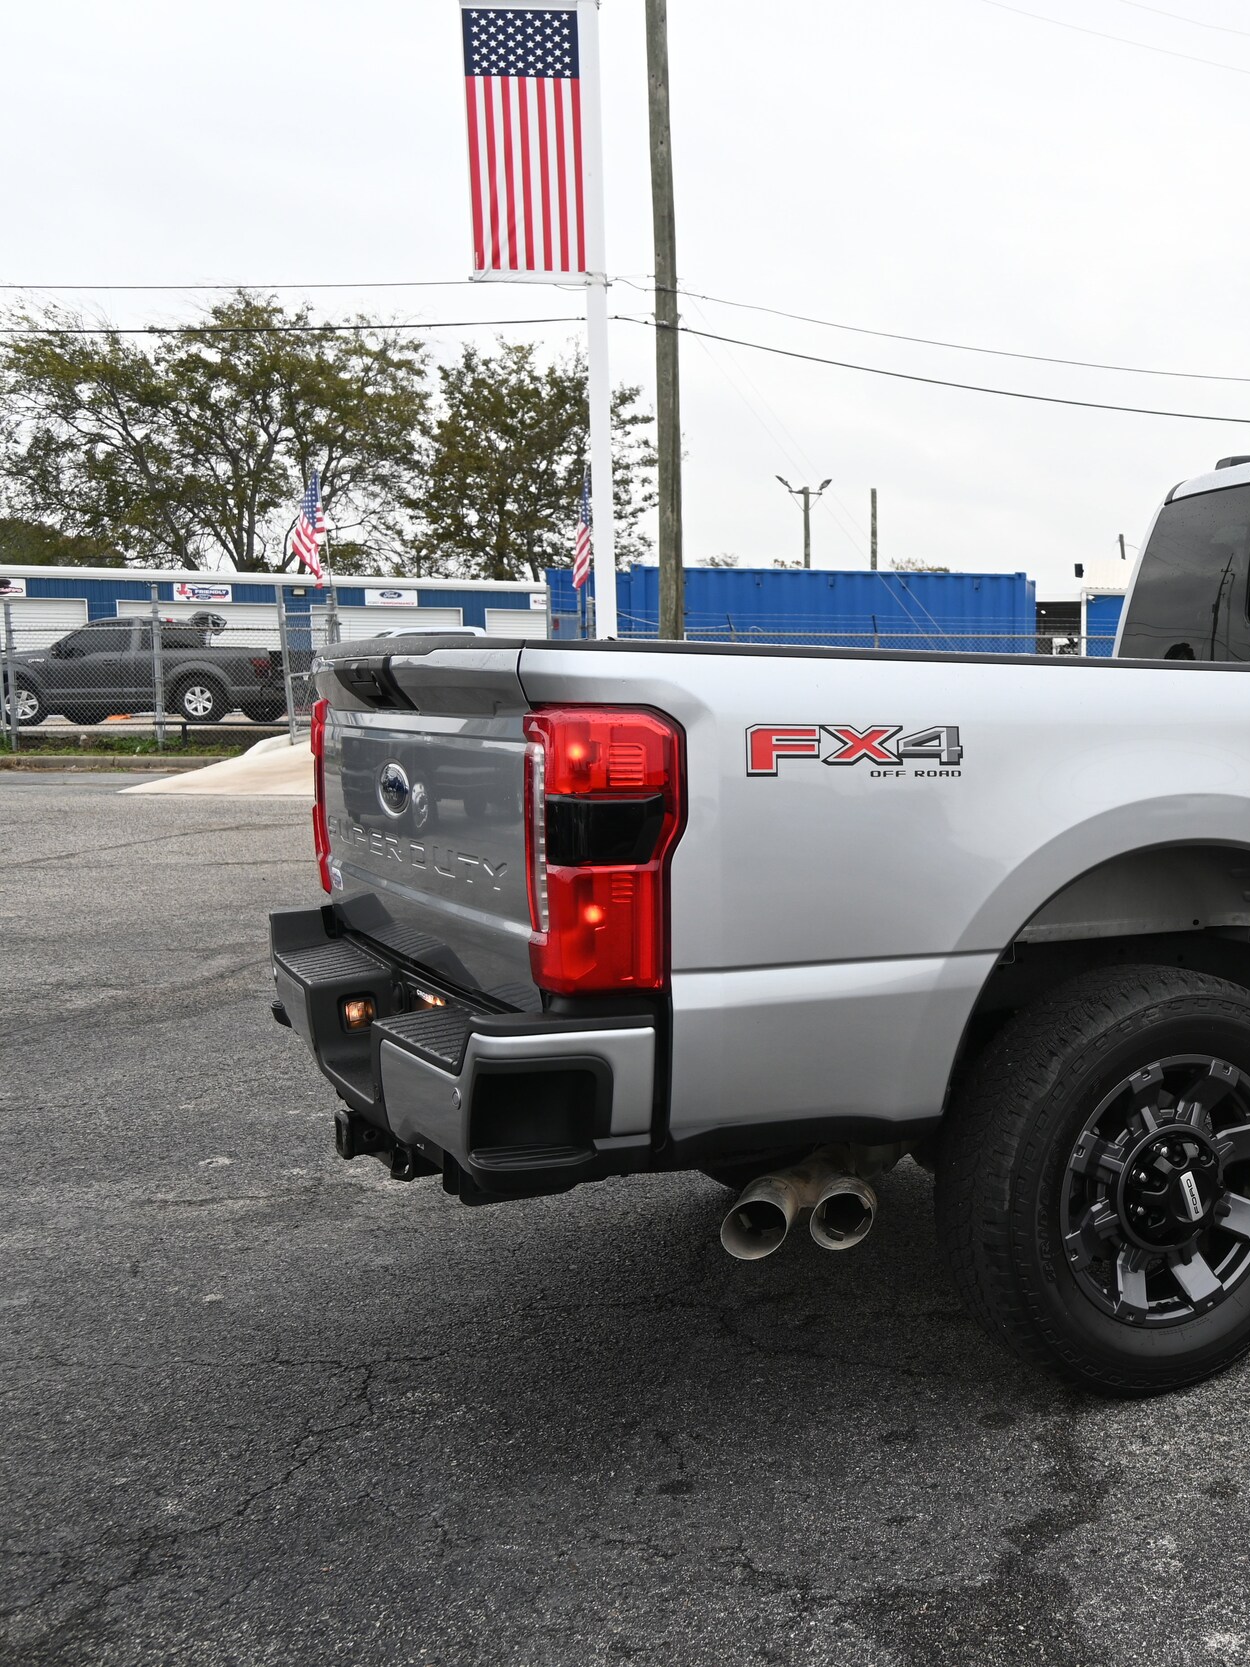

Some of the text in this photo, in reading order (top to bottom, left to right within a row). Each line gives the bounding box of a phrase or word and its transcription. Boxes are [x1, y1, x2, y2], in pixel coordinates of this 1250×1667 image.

[745, 724, 963, 777] FX4
[870, 770, 962, 778] OFF ROAD
[328, 815, 508, 891] SUPER DUTY
[1185, 1178, 1200, 1215] FORD
